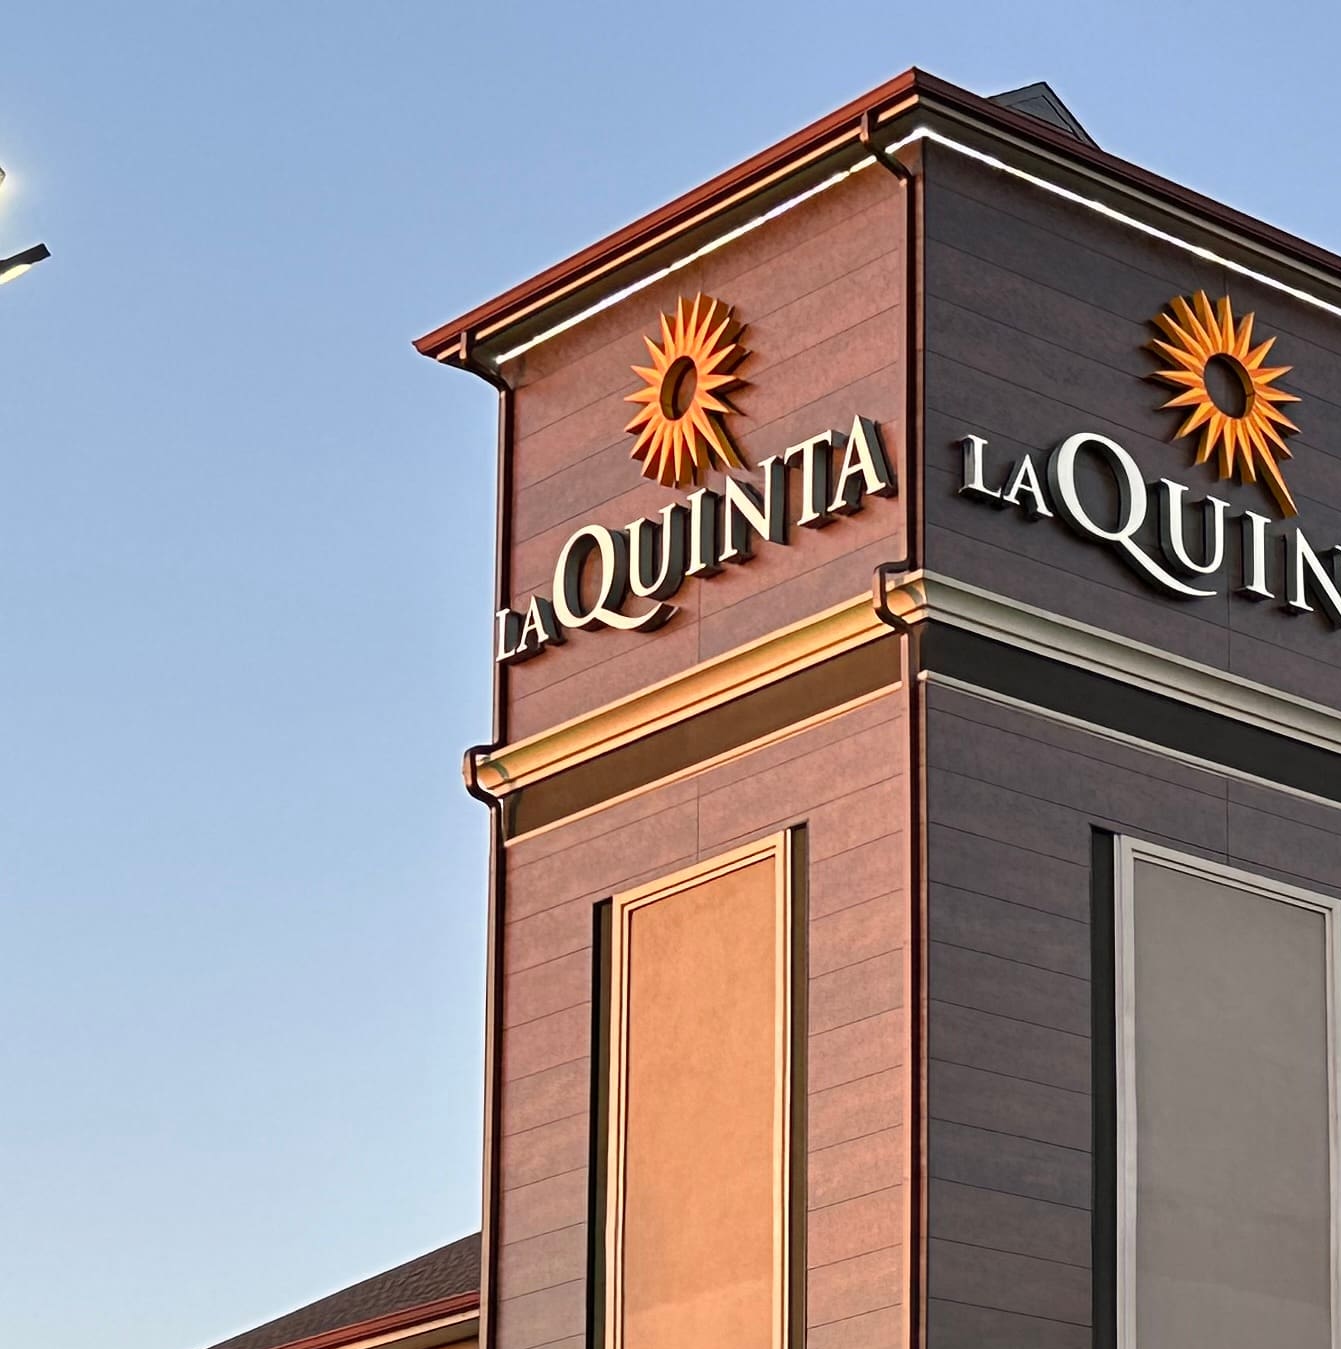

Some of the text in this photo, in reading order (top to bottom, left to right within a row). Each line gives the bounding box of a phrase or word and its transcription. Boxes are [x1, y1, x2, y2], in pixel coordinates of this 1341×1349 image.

[495, 413, 892, 664] LA QUINTA
[958, 433, 1054, 519] LA
